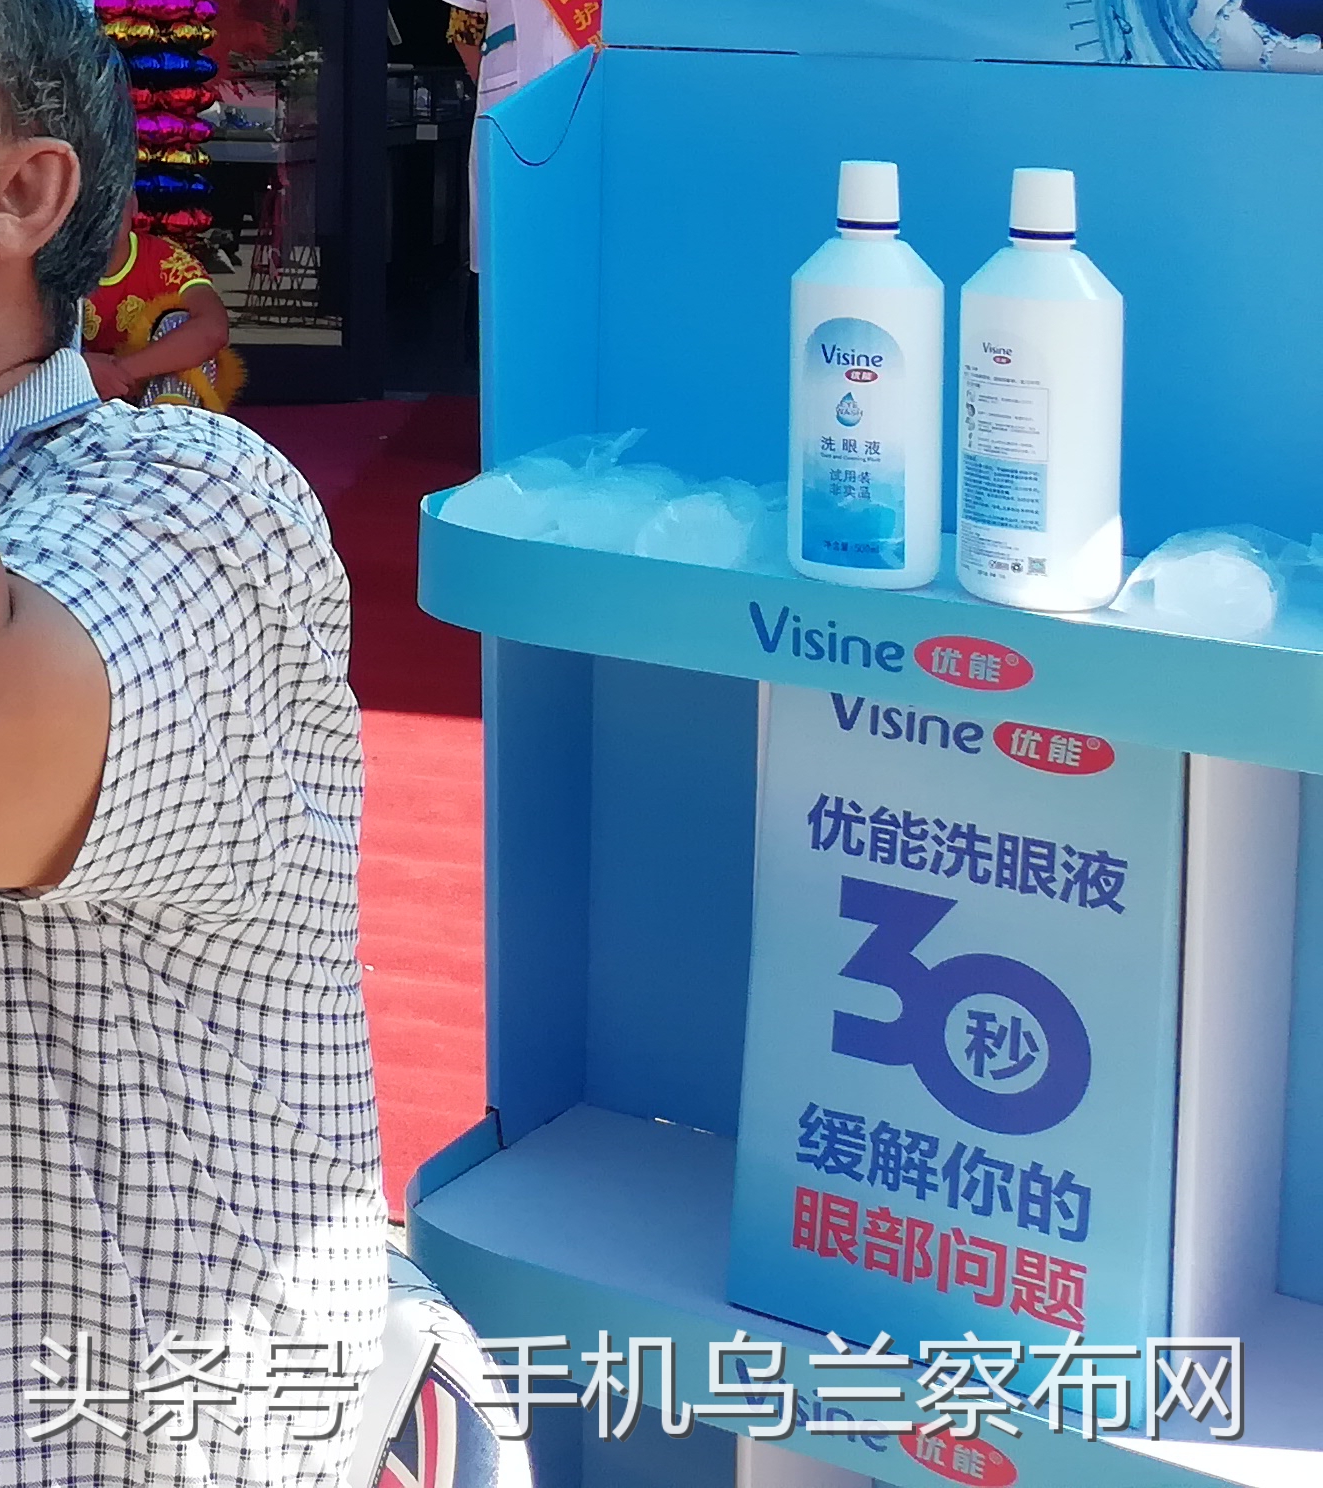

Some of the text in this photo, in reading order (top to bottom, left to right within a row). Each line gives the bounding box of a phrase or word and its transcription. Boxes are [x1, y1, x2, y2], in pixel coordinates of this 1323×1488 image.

[820, 343, 884, 369] Visine
[820, 436, 882, 456] 洗眼液
[748, 601, 1002, 686] Visine 优能
[831, 692, 1084, 769] Visine 优能
[806, 791, 1128, 915] 优能洗眼液
[794, 1100, 1093, 1244] 缓解你的
[791, 1185, 1089, 1332] 眼部问题
[915, 1433, 986, 1480] 优能
